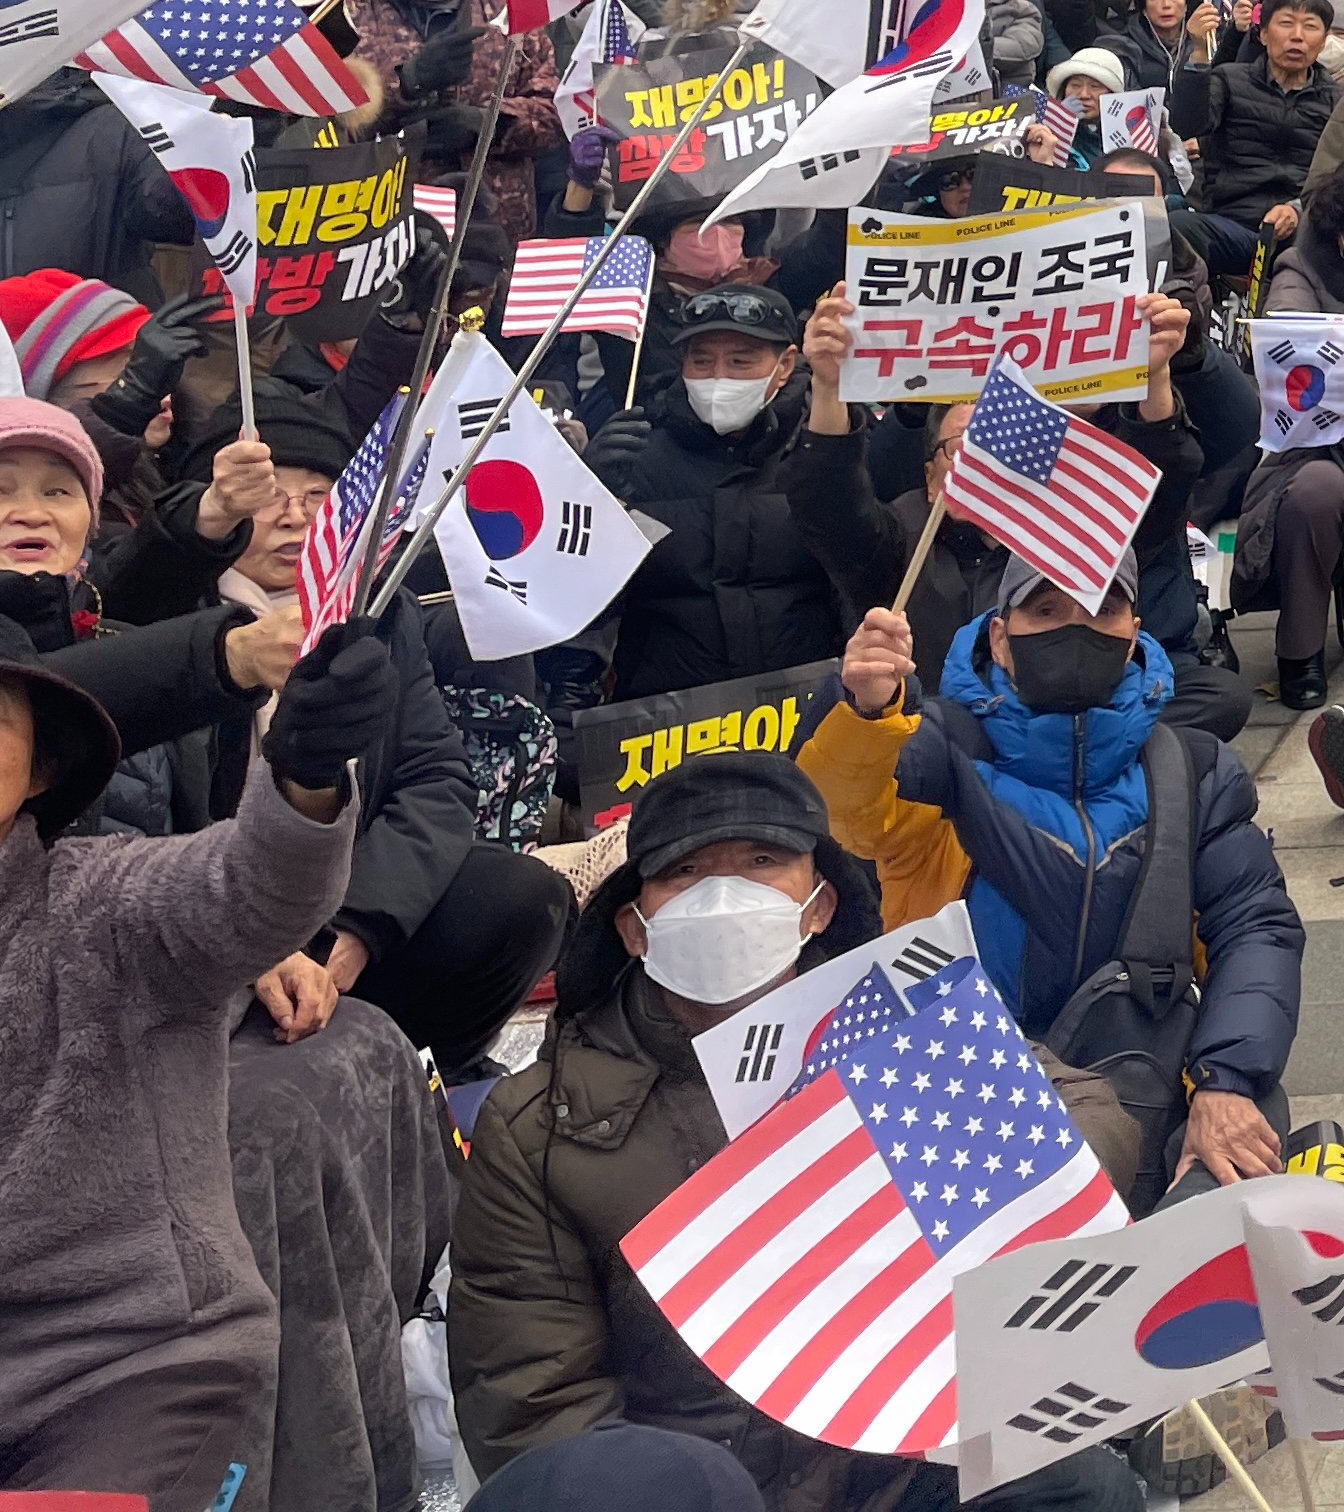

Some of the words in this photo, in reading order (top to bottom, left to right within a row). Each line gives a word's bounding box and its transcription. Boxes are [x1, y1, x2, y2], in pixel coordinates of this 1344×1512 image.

[624, 59, 785, 130] 재명아!
[929, 101, 1019, 133] 명아!
[616, 126, 707, 183] 깜방
[945, 112, 1032, 146] 가자!
[256, 155, 408, 247] 재명아!
[956, 223, 993, 238] POLICE
[994, 217, 1017, 230] LINE
[337, 214, 416, 303] 가자!
[898, 230, 921, 240] LINE
[857, 250, 1024, 307] 문재인
[1031, 230, 1136, 298] 조국
[853, 294, 1143, 378] 구속하라
[1044, 384, 1080, 397] POLICE
[1081, 379, 1103, 391] LINE
